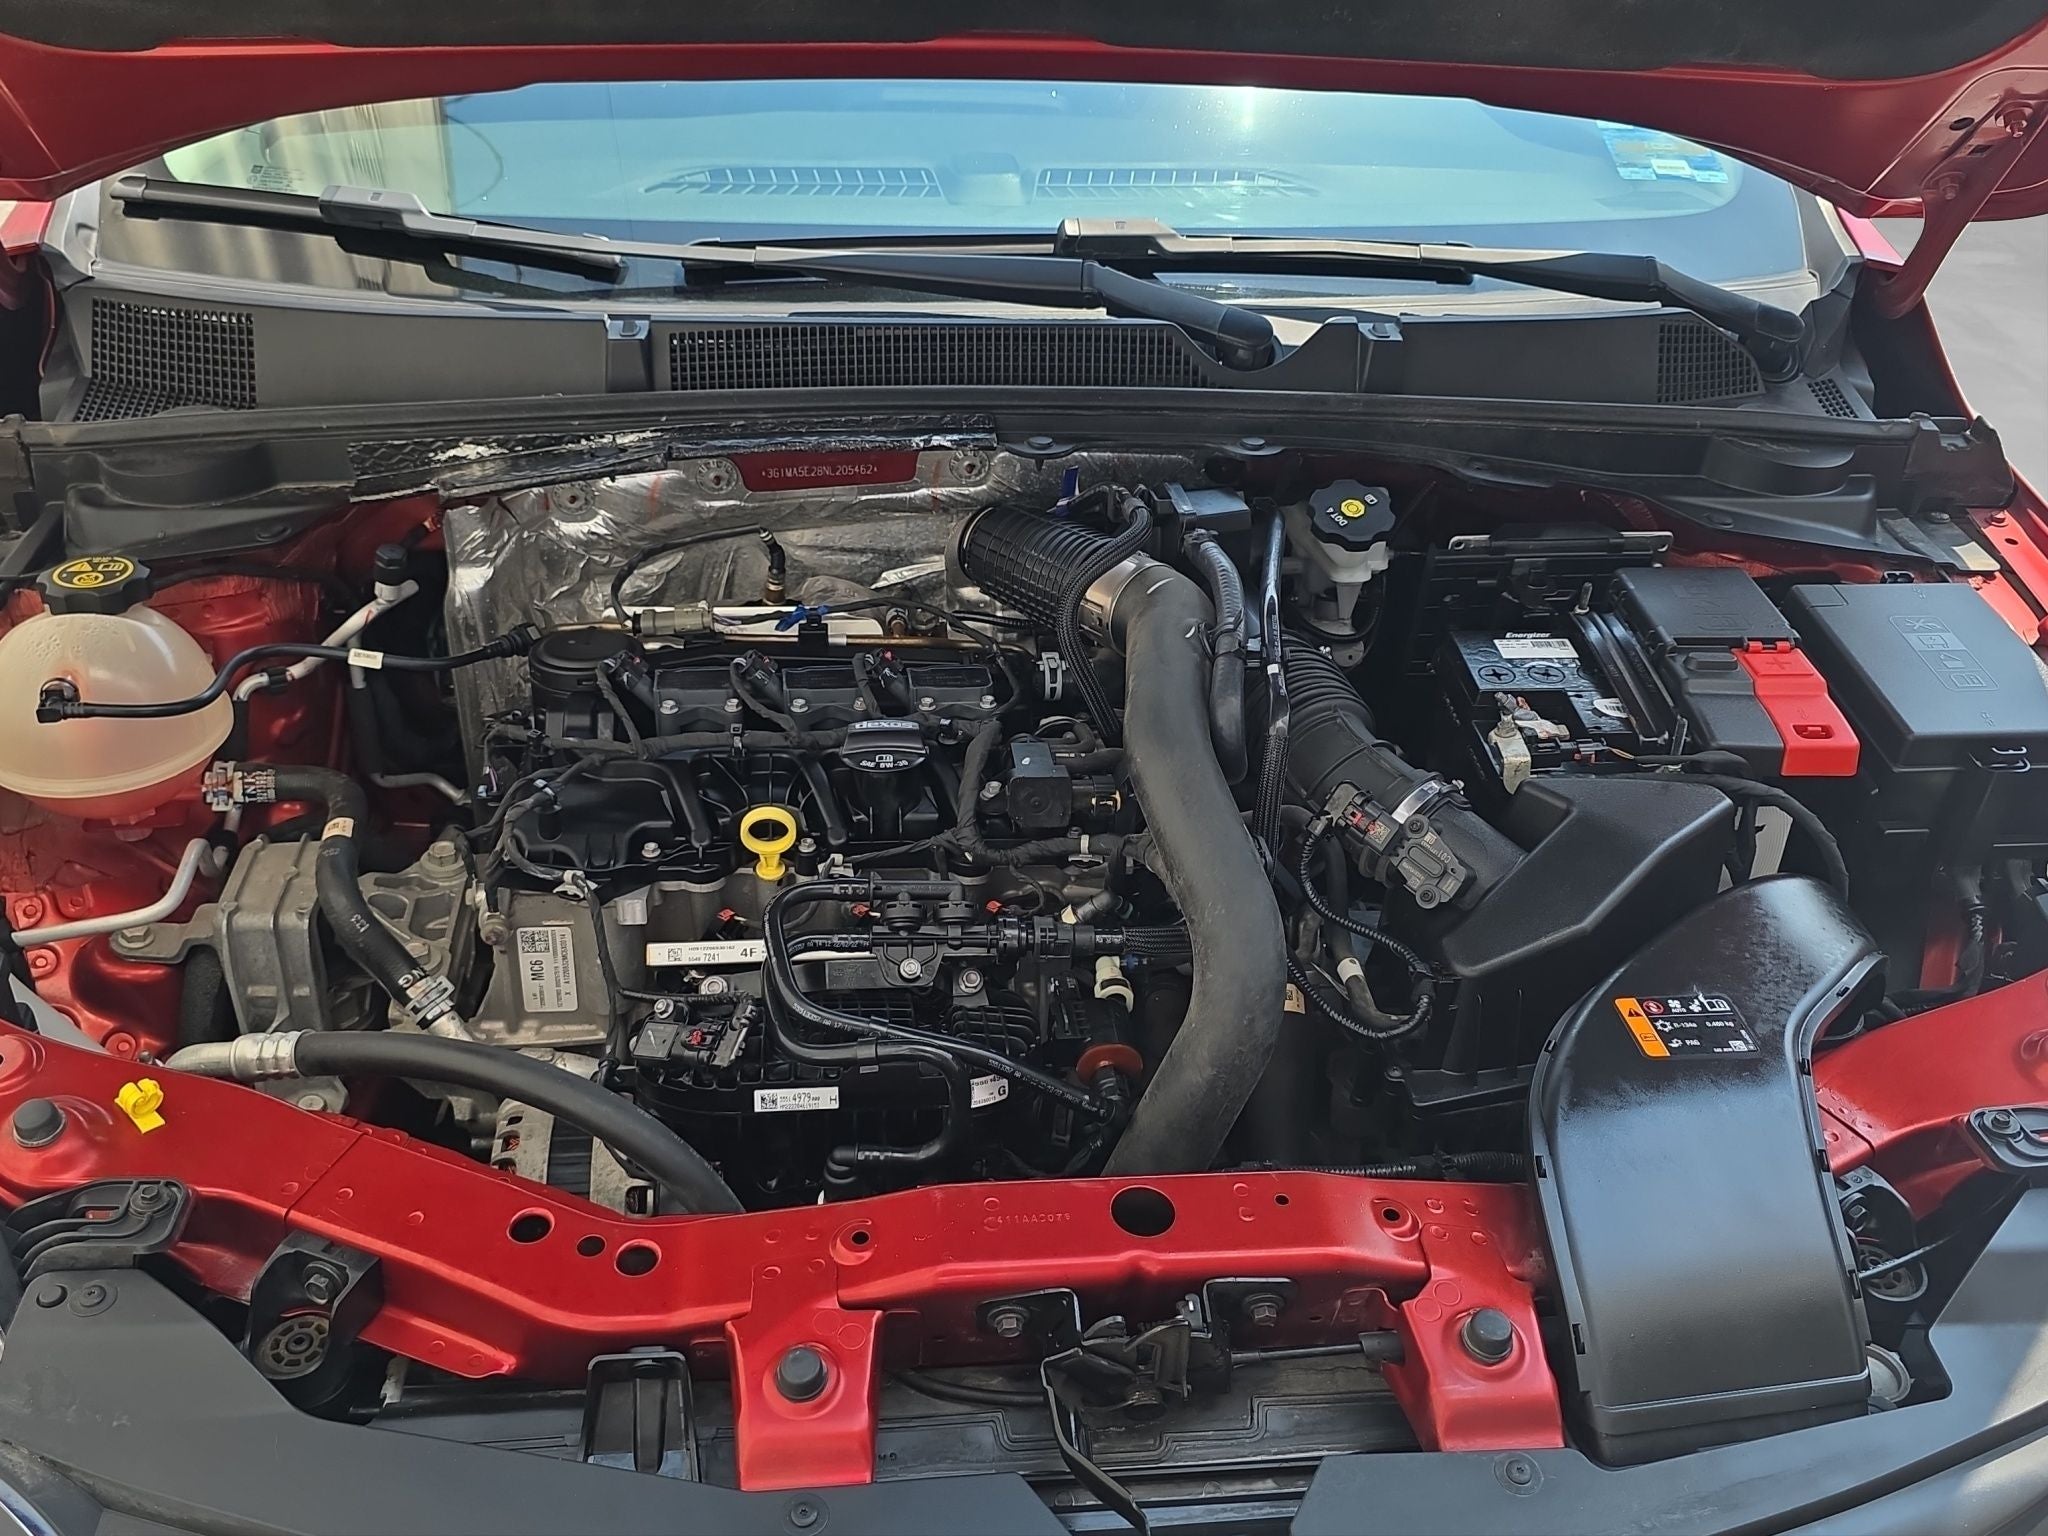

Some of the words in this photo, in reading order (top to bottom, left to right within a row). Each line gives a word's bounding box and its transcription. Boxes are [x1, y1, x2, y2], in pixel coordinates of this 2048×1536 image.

[1330, 512, 1349, 527] DOT
[855, 720, 913, 729] dexos
[860, 760, 876, 768] SAE
[703, 953, 720, 962] 7241
[740, 947, 757, 958] 4F
[530, 959, 545, 981] MC6
[998, 1085, 1007, 1097] G
